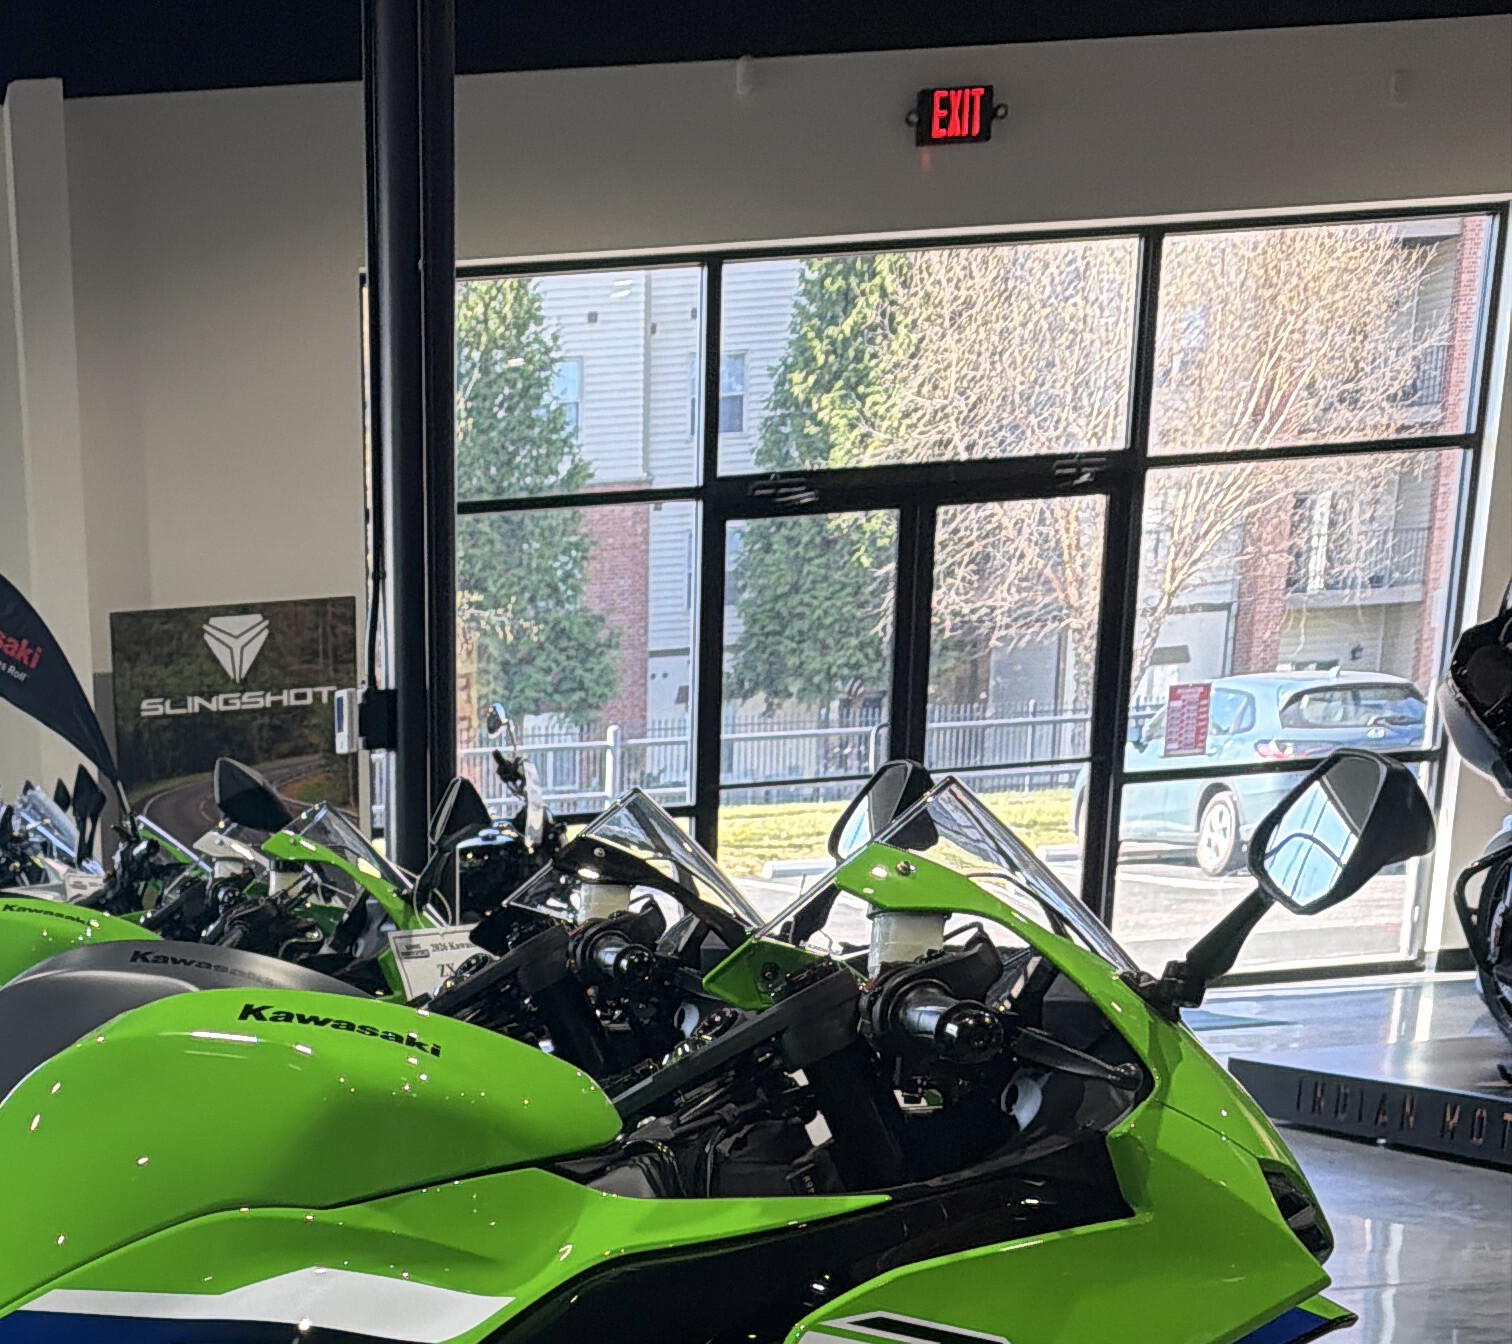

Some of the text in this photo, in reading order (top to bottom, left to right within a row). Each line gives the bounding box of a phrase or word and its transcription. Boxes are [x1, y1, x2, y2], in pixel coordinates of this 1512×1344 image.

[931, 87, 985, 139] EXIT
[7, 664, 28, 683] Roll
[140, 685, 337, 717] SLINGSHOT
[238, 1003, 441, 1058] Kawasaki
[1296, 1077, 1417, 1131] INDIAN
